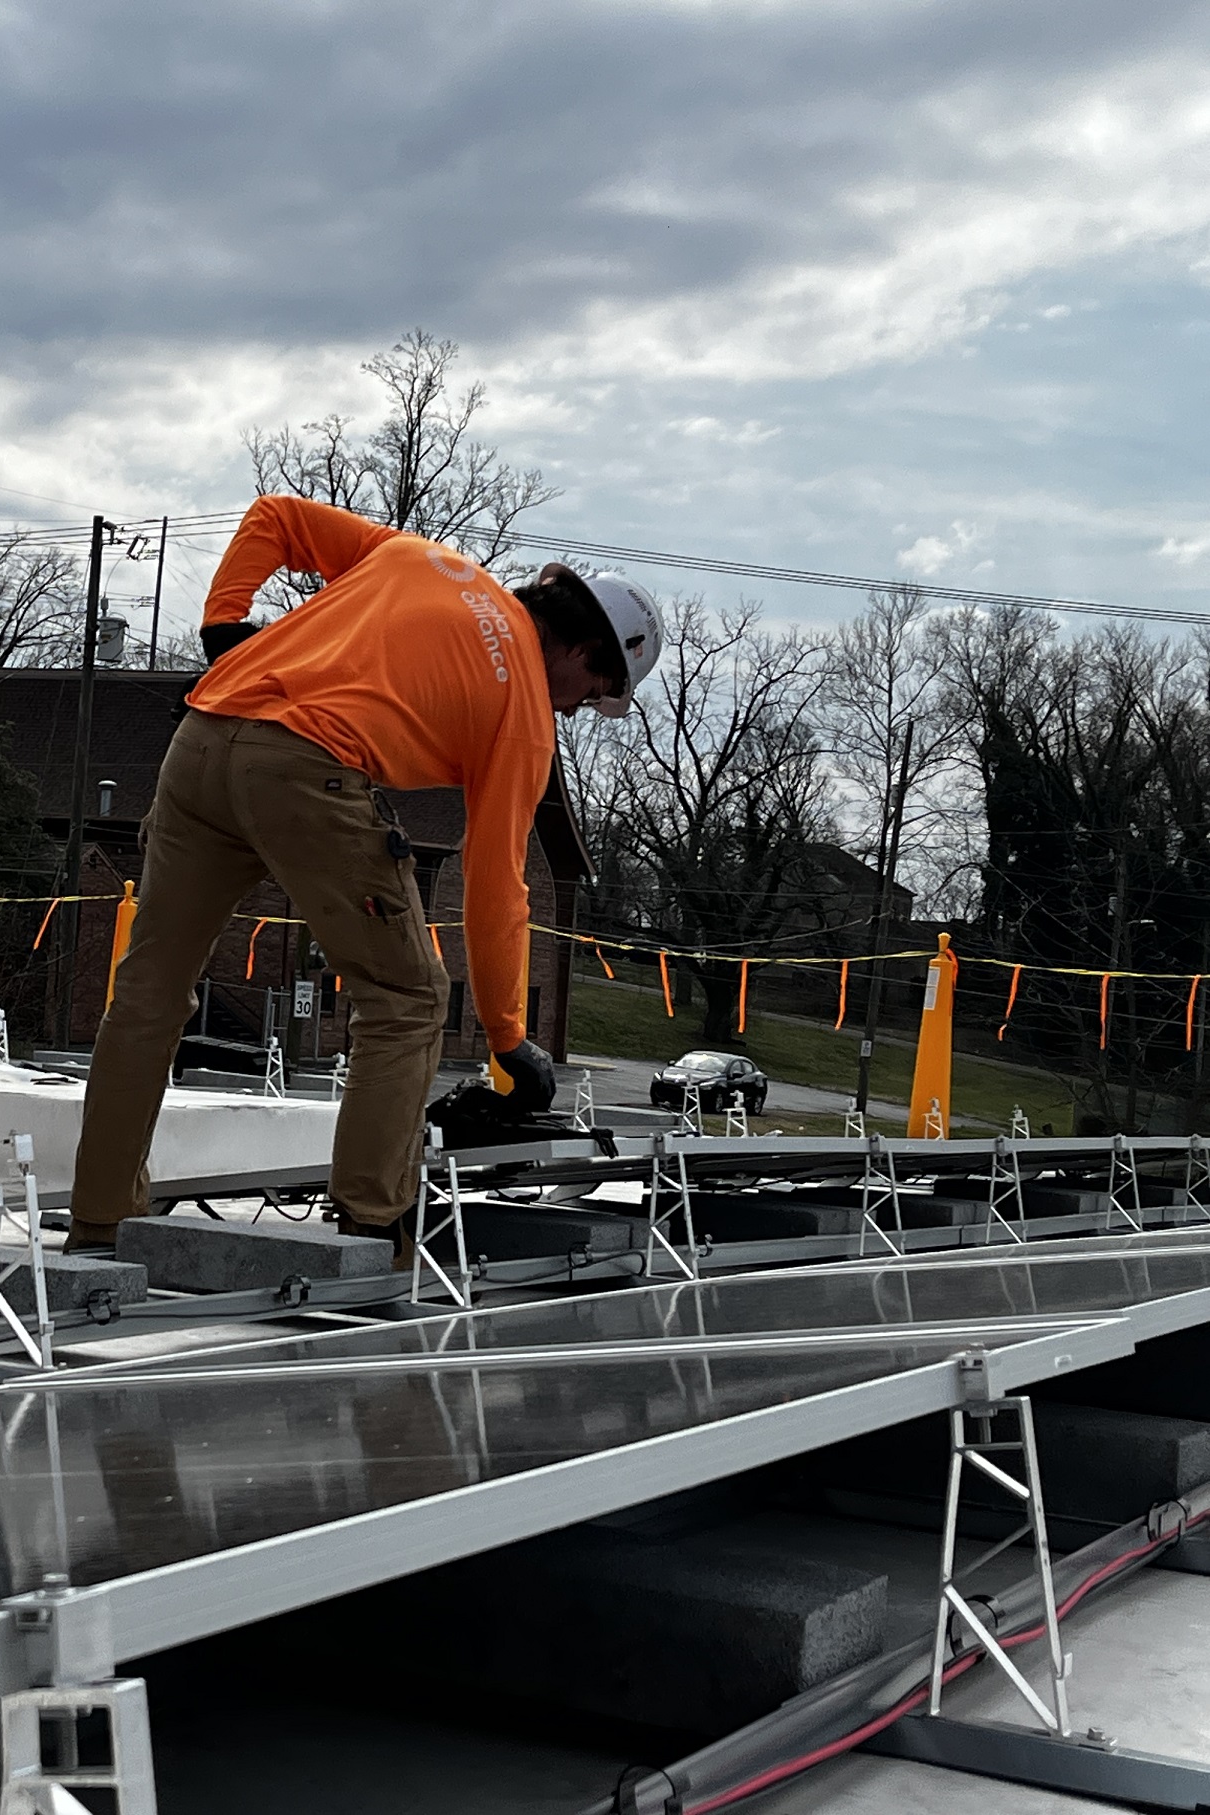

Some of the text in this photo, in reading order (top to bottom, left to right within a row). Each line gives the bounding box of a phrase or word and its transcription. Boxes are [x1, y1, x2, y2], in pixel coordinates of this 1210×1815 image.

[460, 590, 508, 682] alliance
[477, 593, 513, 643] solar
[295, 1000, 311, 1015] 30
